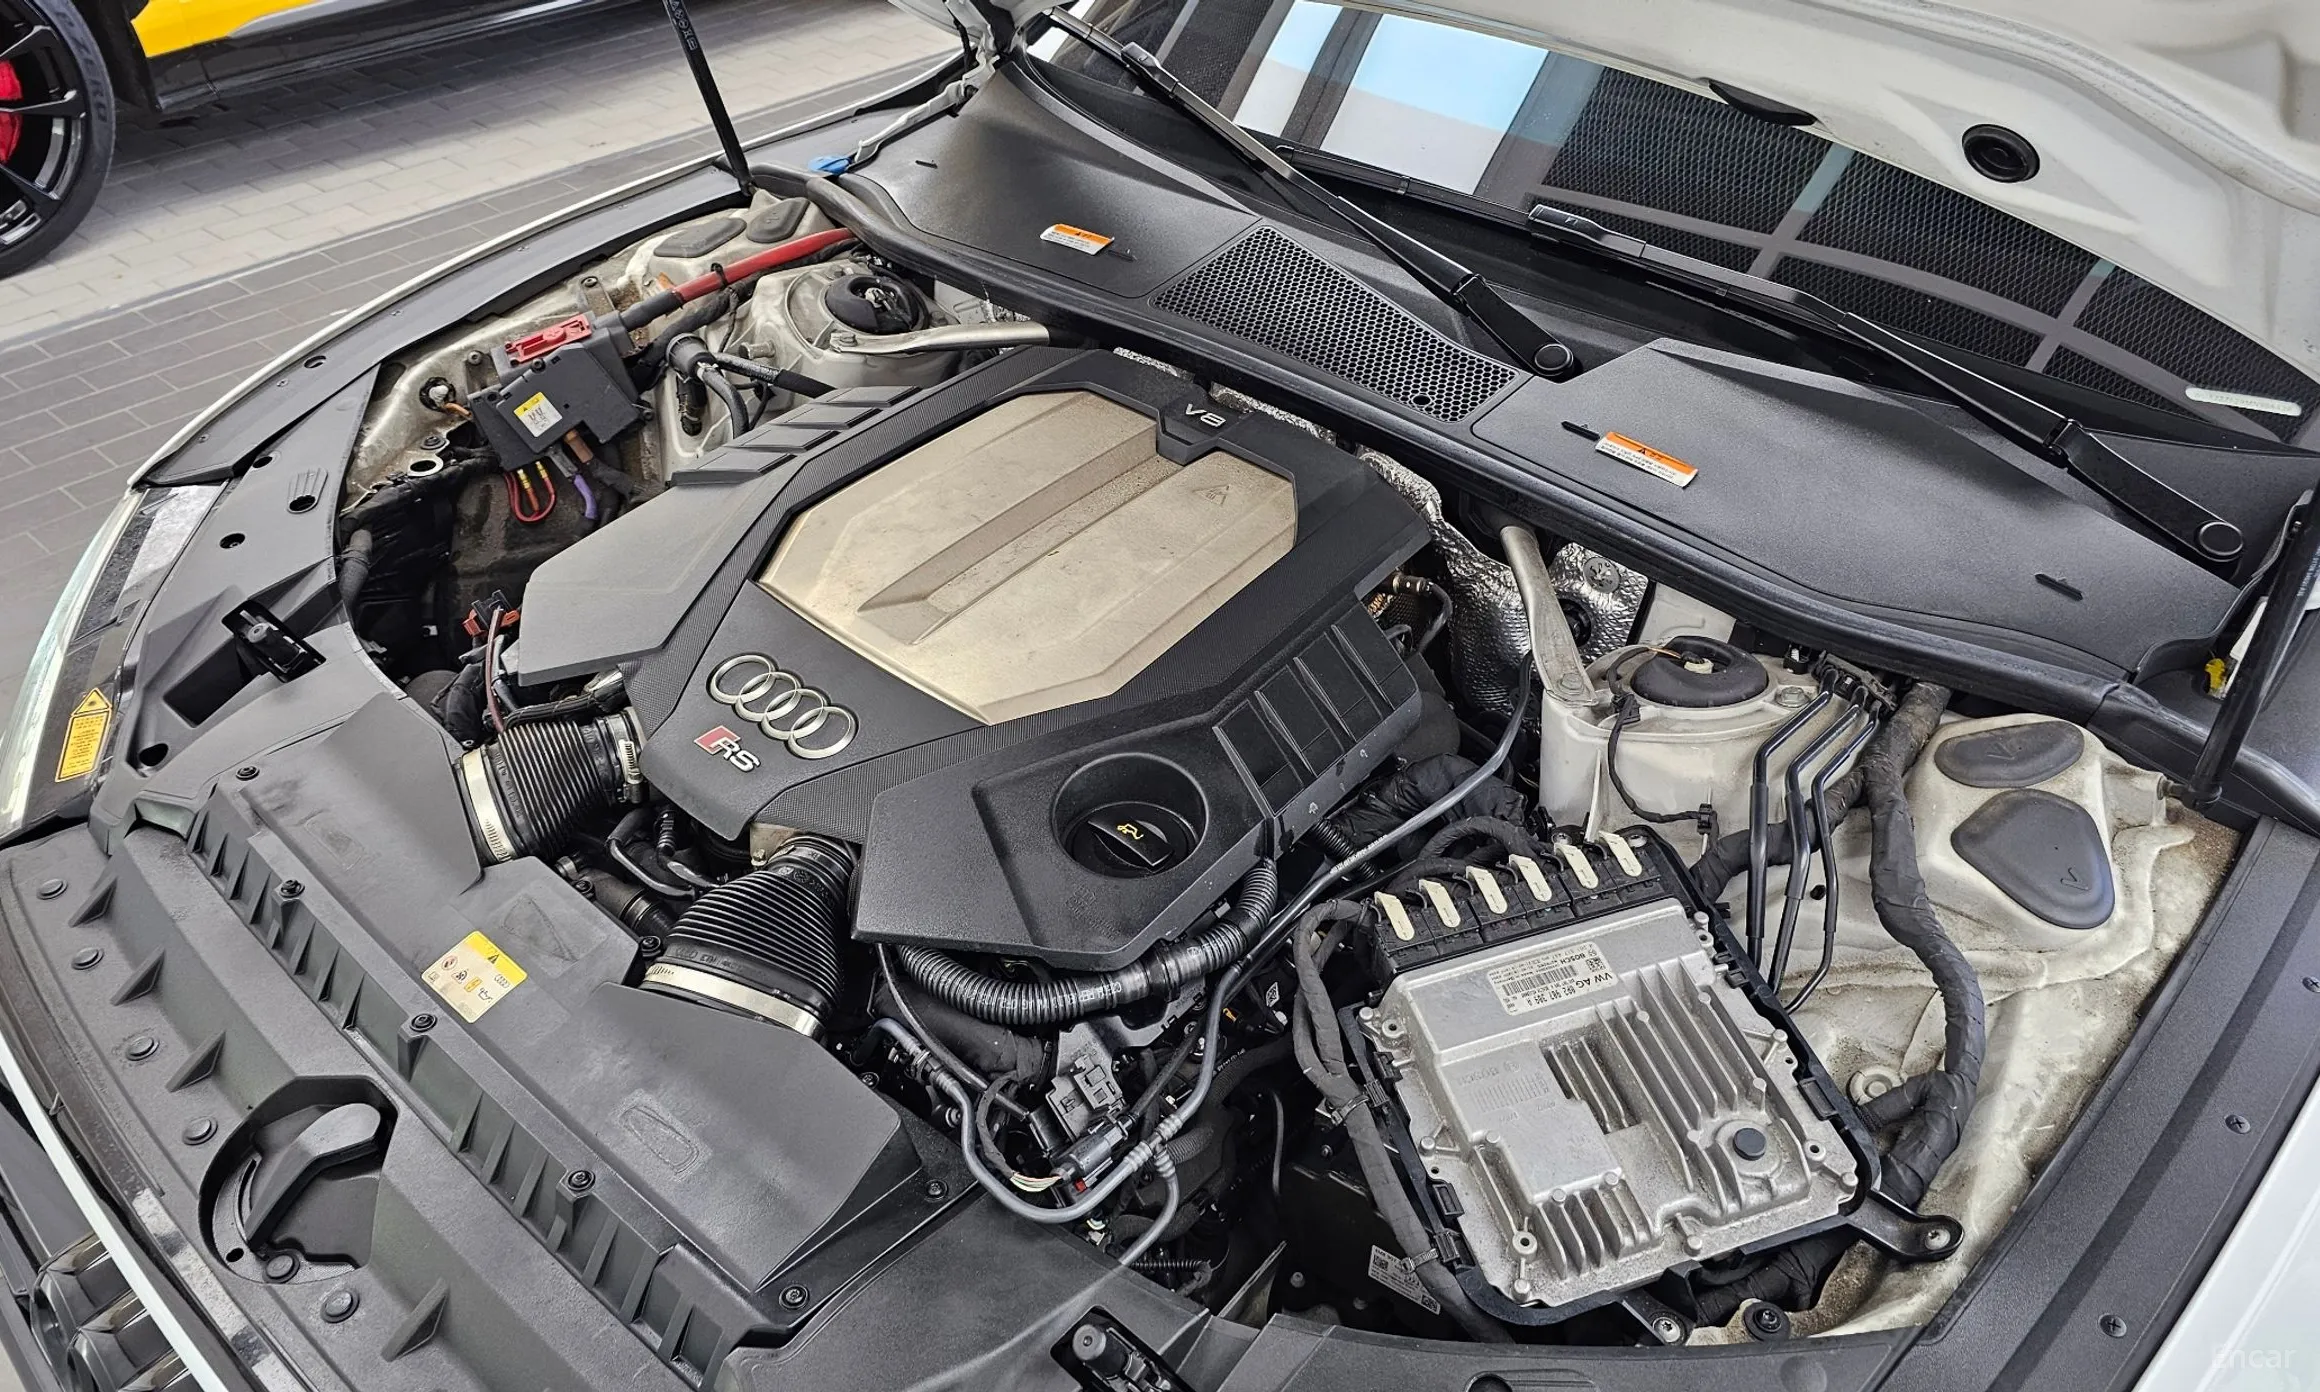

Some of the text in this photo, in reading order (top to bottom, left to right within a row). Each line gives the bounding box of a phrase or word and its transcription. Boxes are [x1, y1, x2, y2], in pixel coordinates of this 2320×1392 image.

[71, 36, 108, 122] ZERO
[1185, 403, 1227, 428] V8
[707, 735, 761, 773] RS
[1560, 952, 1586, 964] BOSCH
[1575, 977, 1591, 989] AG
[1594, 972, 1613, 984] VW
